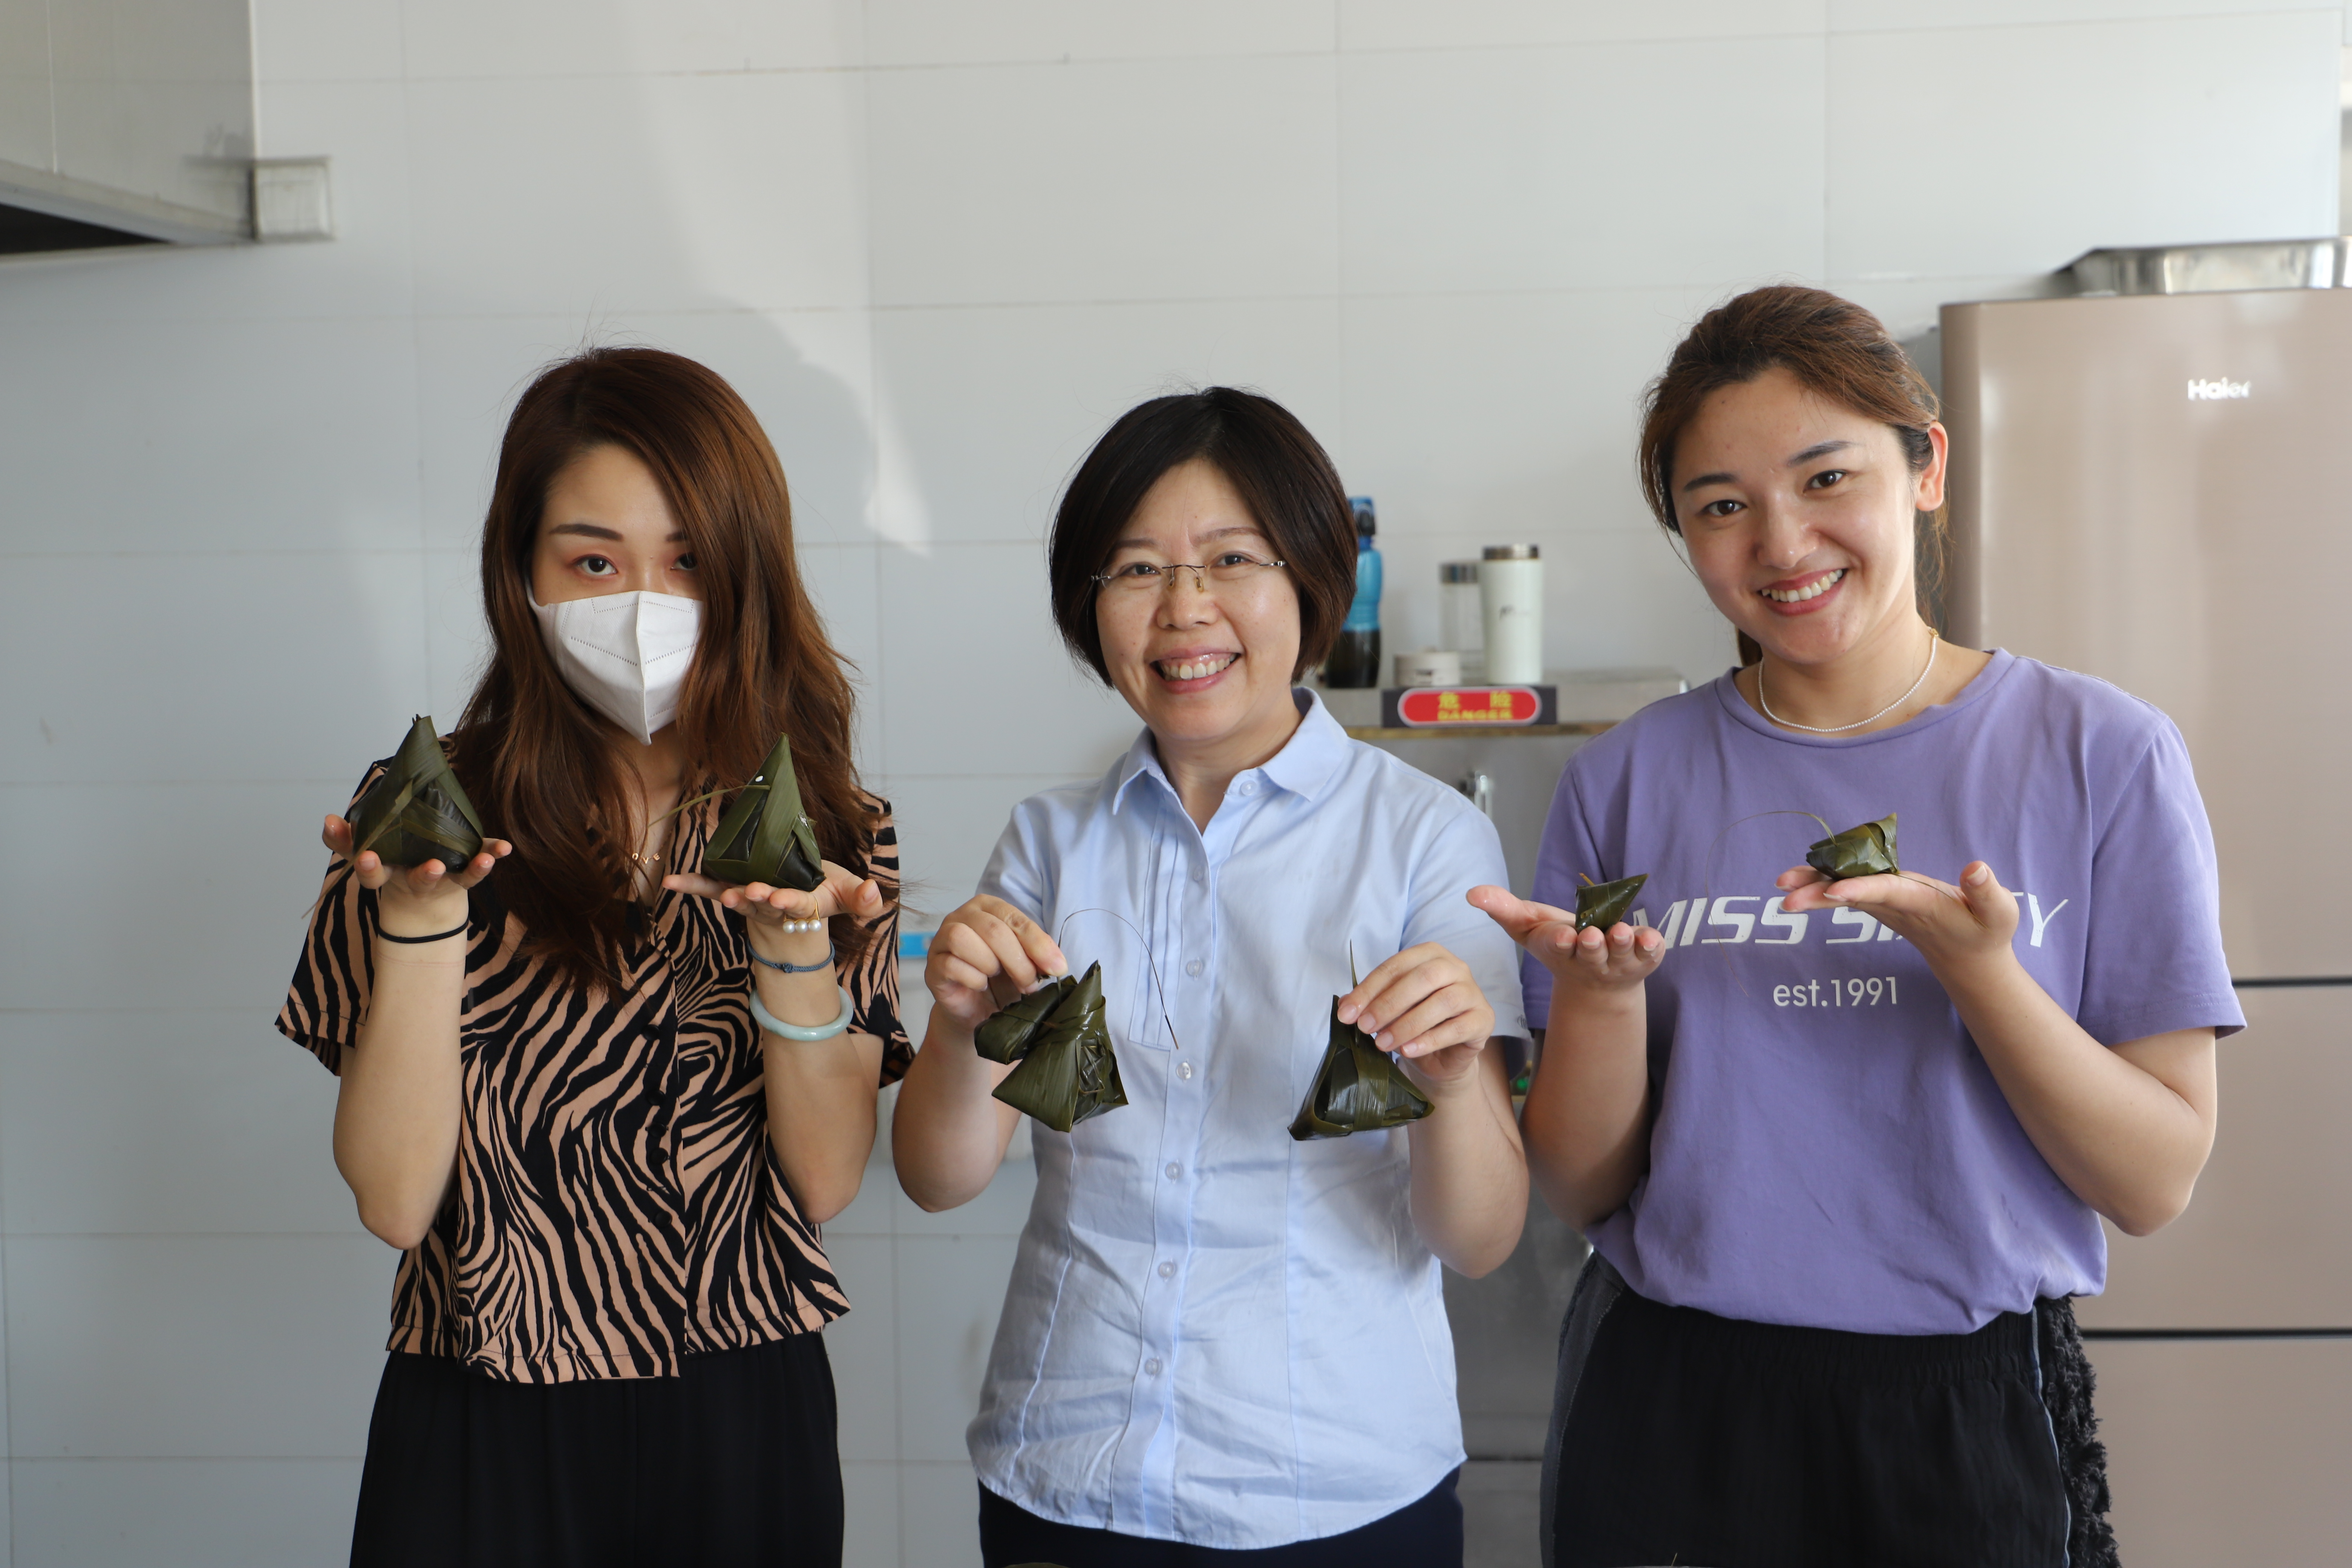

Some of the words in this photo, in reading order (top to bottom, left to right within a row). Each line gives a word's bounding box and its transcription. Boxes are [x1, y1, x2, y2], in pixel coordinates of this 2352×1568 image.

[2188, 377, 2251, 400] Haier
[1438, 709, 1512, 721] DANGER
[1633, 896, 1809, 949] MISS
[1773, 977, 1897, 1007] est.1991
